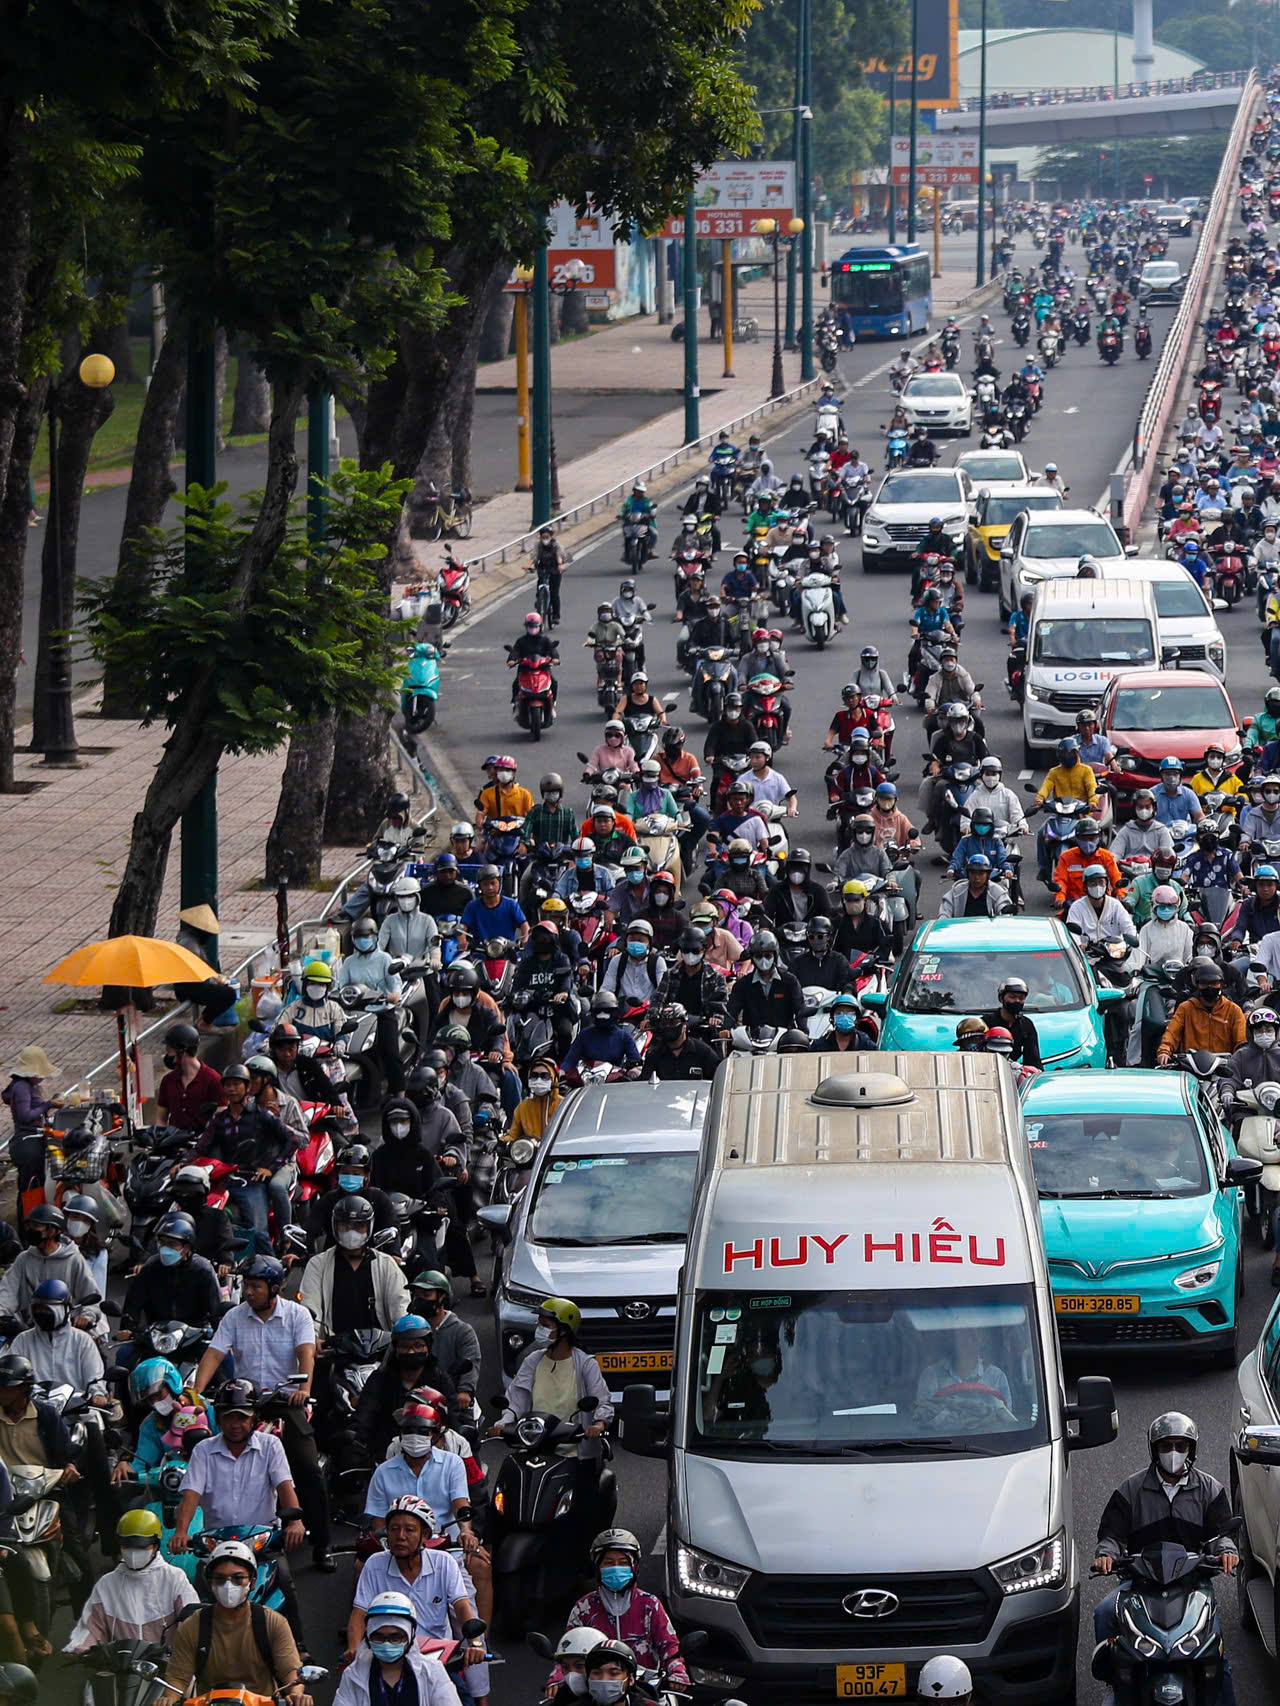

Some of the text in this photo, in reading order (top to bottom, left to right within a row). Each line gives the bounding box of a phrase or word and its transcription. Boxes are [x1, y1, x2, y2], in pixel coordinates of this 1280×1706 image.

[715, 220, 743, 233] 331
[553, 264, 595, 283] 26
[1055, 672, 1116, 682] LOGIH
[1028, 1141, 1048, 1149] AXI
[722, 1216, 1006, 1275] HUY HIẾU
[1061, 1298, 1133, 1310] 50H-328.85
[855, 1665, 886, 1680] 93F
[844, 1681, 899, 1695] 000.47
